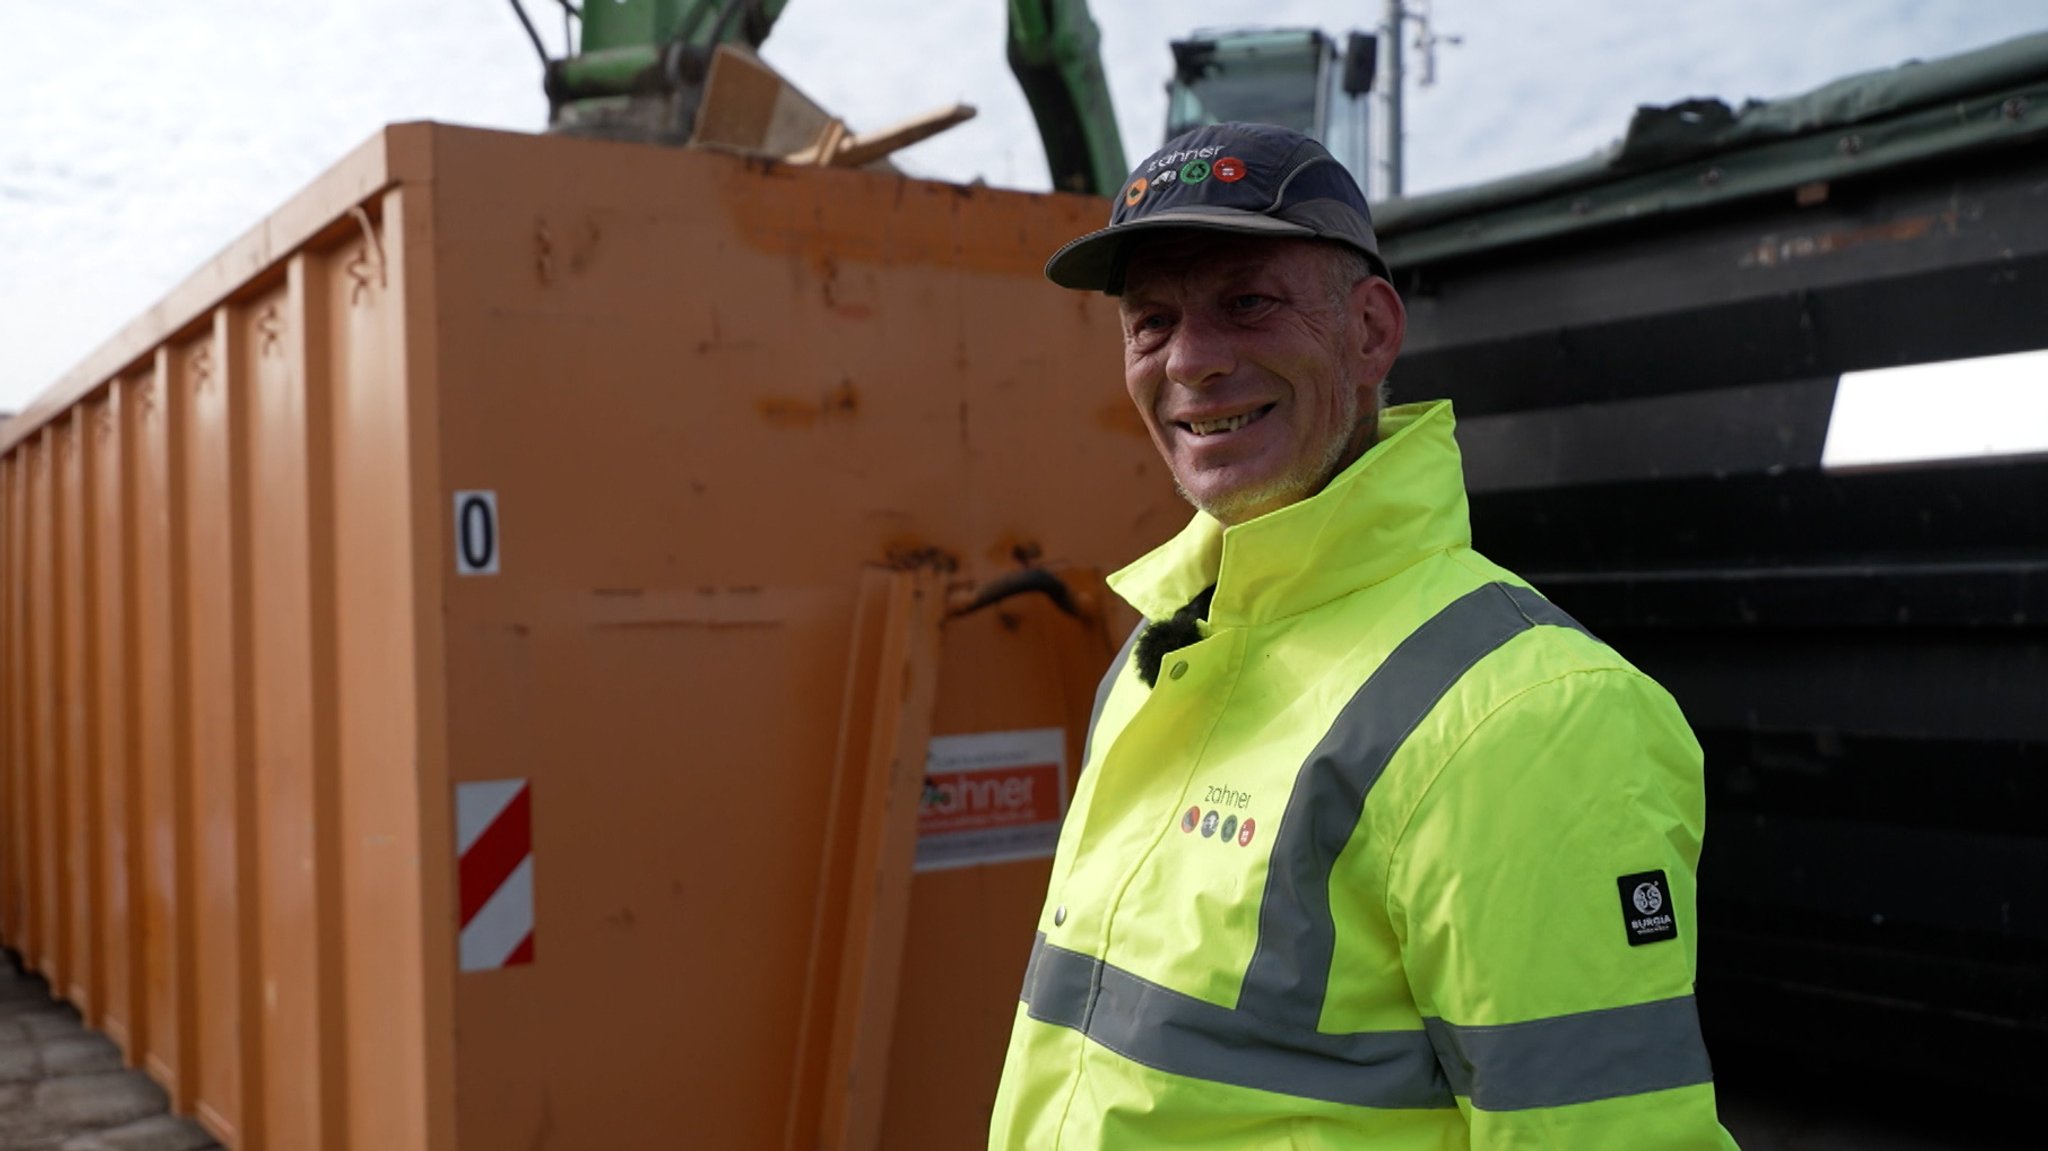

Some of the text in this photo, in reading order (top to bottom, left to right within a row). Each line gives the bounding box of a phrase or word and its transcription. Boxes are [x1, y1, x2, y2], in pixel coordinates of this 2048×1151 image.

[1147, 145, 1225, 173] zahner
[1204, 783, 1252, 809] zahner
[1631, 914, 1672, 930] BURGIA
